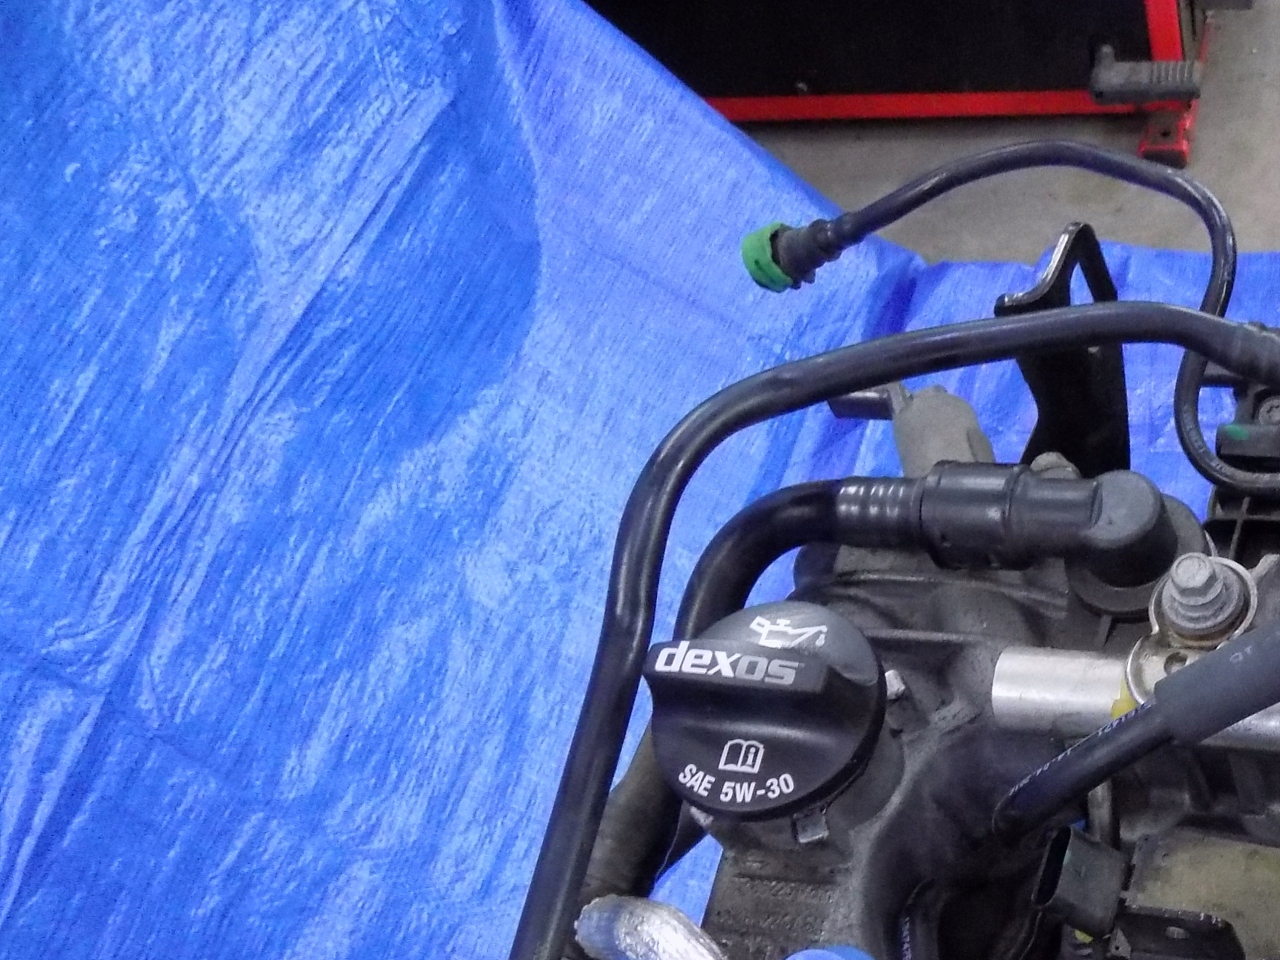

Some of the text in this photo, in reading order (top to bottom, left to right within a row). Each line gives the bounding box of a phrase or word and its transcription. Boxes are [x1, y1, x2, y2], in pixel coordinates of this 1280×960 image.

[654, 641, 800, 685] dexos
[678, 764, 795, 803] SAE 5W-30
